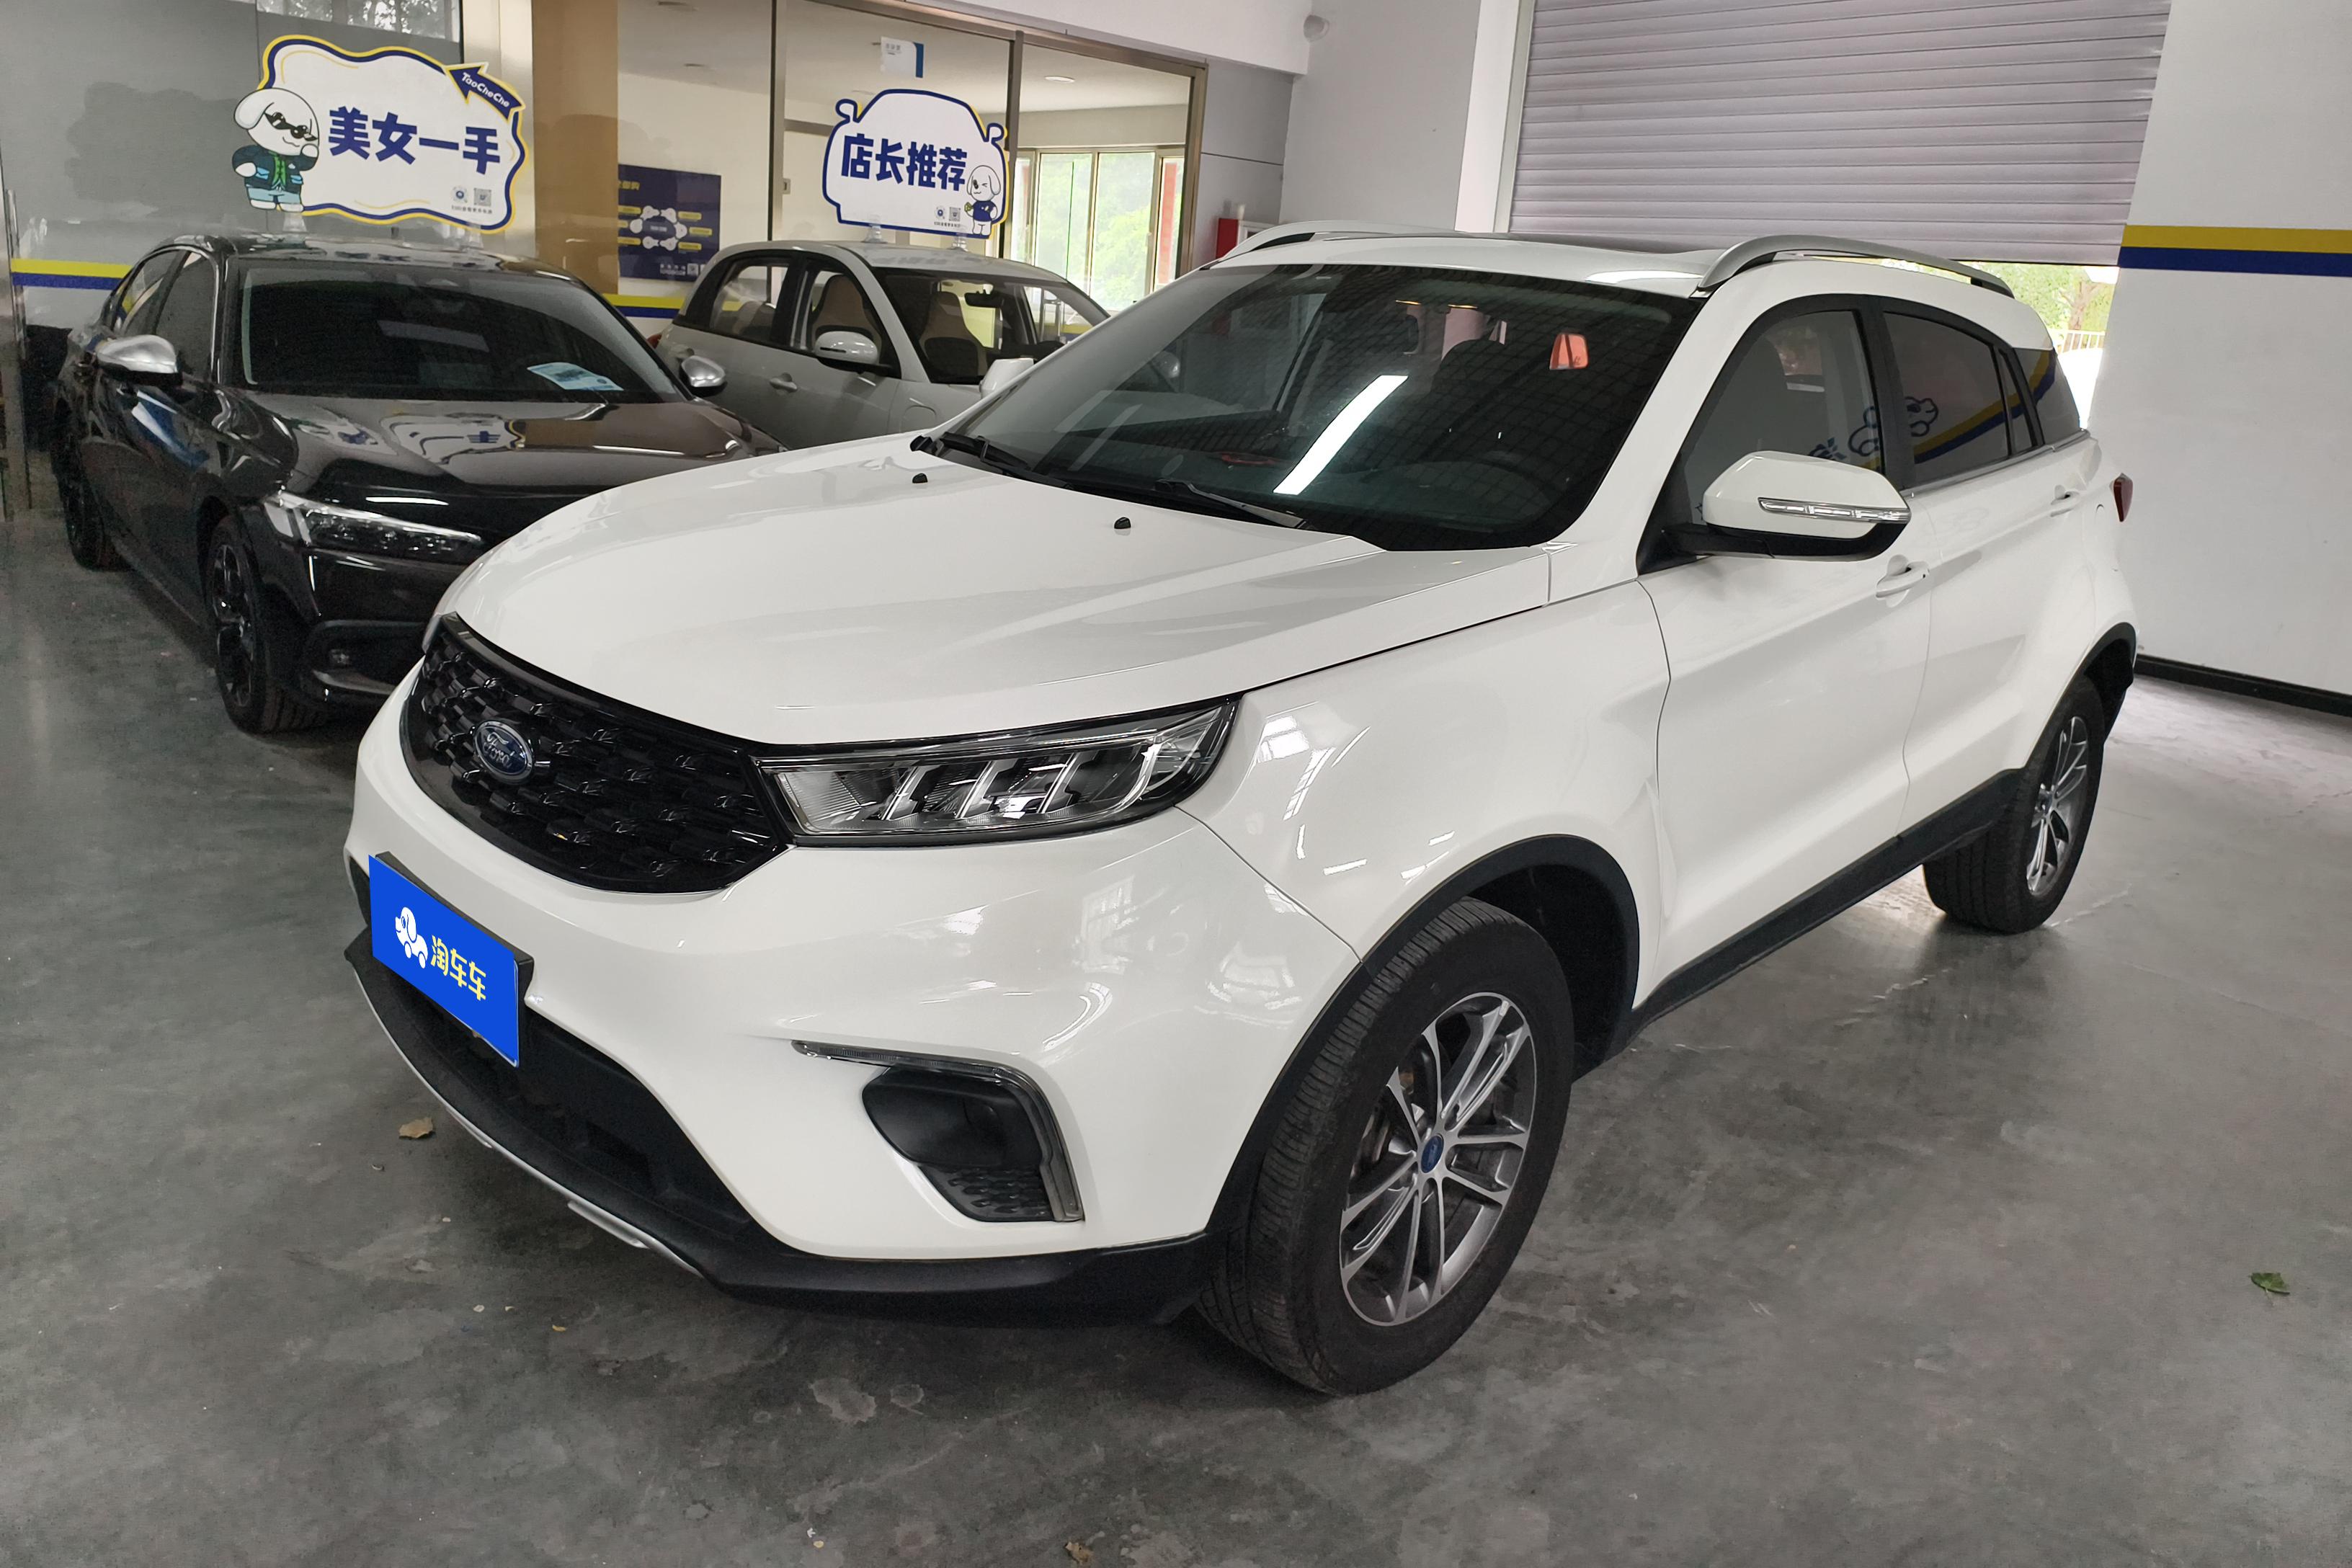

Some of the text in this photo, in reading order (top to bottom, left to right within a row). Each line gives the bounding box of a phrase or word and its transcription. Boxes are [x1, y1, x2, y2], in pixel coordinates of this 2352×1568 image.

[461, 72, 510, 107] TaoCheChe
[329, 106, 500, 174] 美女一手
[841, 133, 967, 191] 店长推荐
[482, 731, 516, 768] Ford
